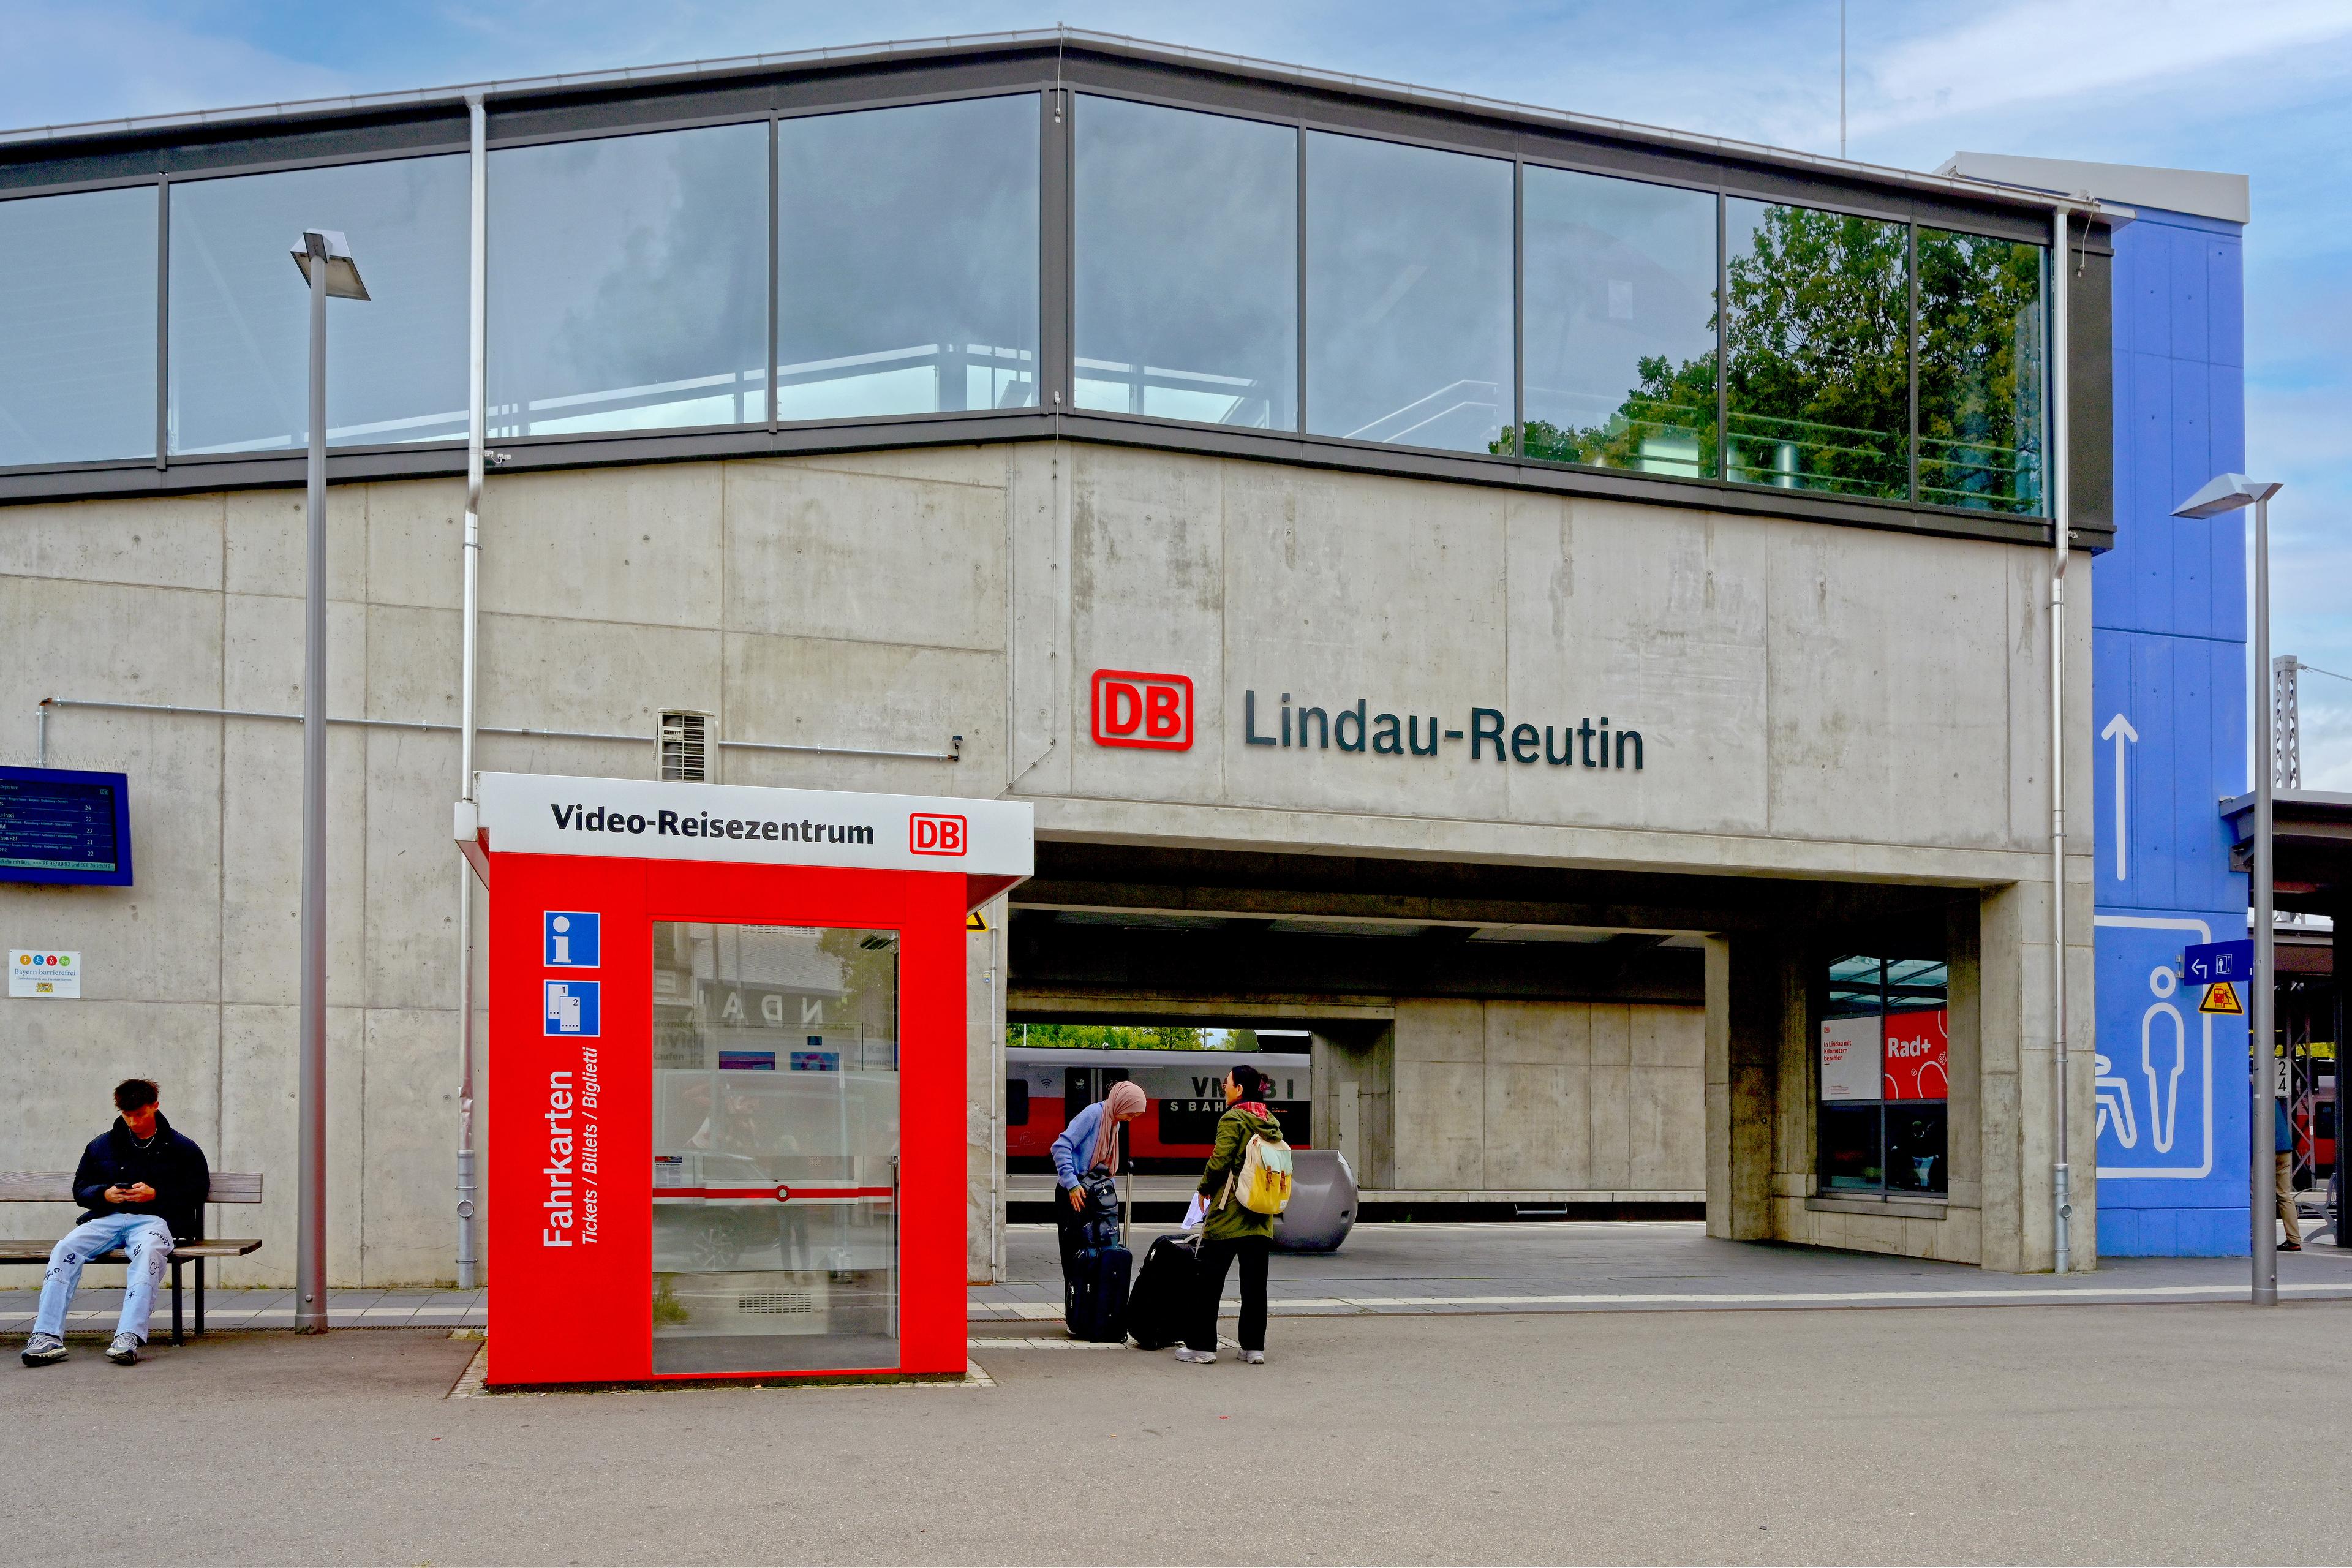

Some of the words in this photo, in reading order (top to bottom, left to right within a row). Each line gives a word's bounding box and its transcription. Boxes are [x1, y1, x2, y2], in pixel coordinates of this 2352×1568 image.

[1106, 682, 1182, 737] DB
[1246, 690, 1643, 771] Lindau-Reutin
[551, 804, 874, 845] Video-Reisezentrum
[918, 820, 960, 851] DB
[1888, 1035, 1931, 1058] Rad+
[2278, 1061, 2286, 1076] 2
[582, 1046, 600, 1109] Biglietti
[1192, 1077, 1294, 1099] VMBI
[2278, 1077, 2286, 1091] 4
[1170, 1101, 1178, 1112] S
[1188, 1102, 1224, 1112] BAH
[543, 1071, 573, 1247] Fahrkarten
[582, 1123, 597, 1174] Billets
[582, 1189, 597, 1245] Tickets
